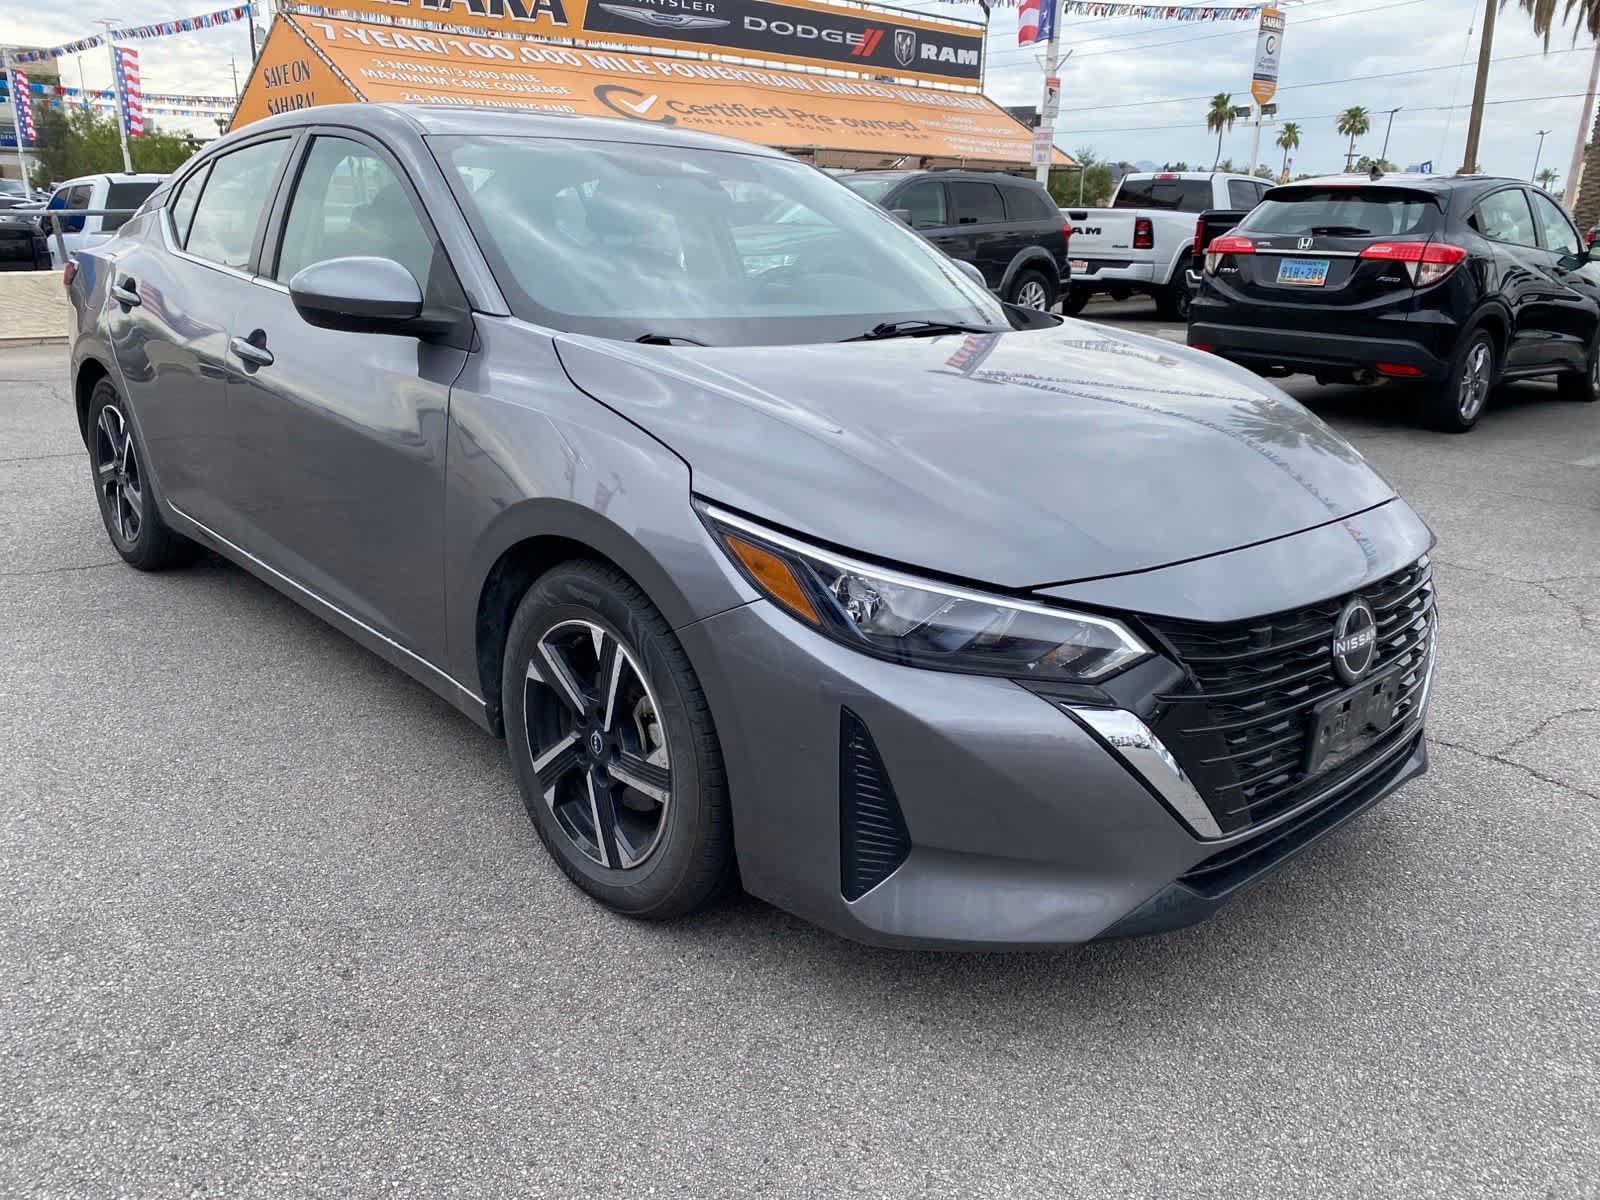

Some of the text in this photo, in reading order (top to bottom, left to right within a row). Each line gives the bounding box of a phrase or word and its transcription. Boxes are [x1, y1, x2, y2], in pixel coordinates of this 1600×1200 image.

[743, 15, 866, 47] DODGE
[920, 42, 978, 66] RAM
[263, 59, 311, 89] SAVE ON
[359, 67, 574, 95] MAXIMUM CARE COVERAGE
[582, 52, 656, 75] MILE
[653, 60, 814, 92] POWERTRAIN
[809, 78, 895, 99] LIMITED
[896, 88, 993, 113] WARRANTY
[665, 99, 790, 119] Certified
